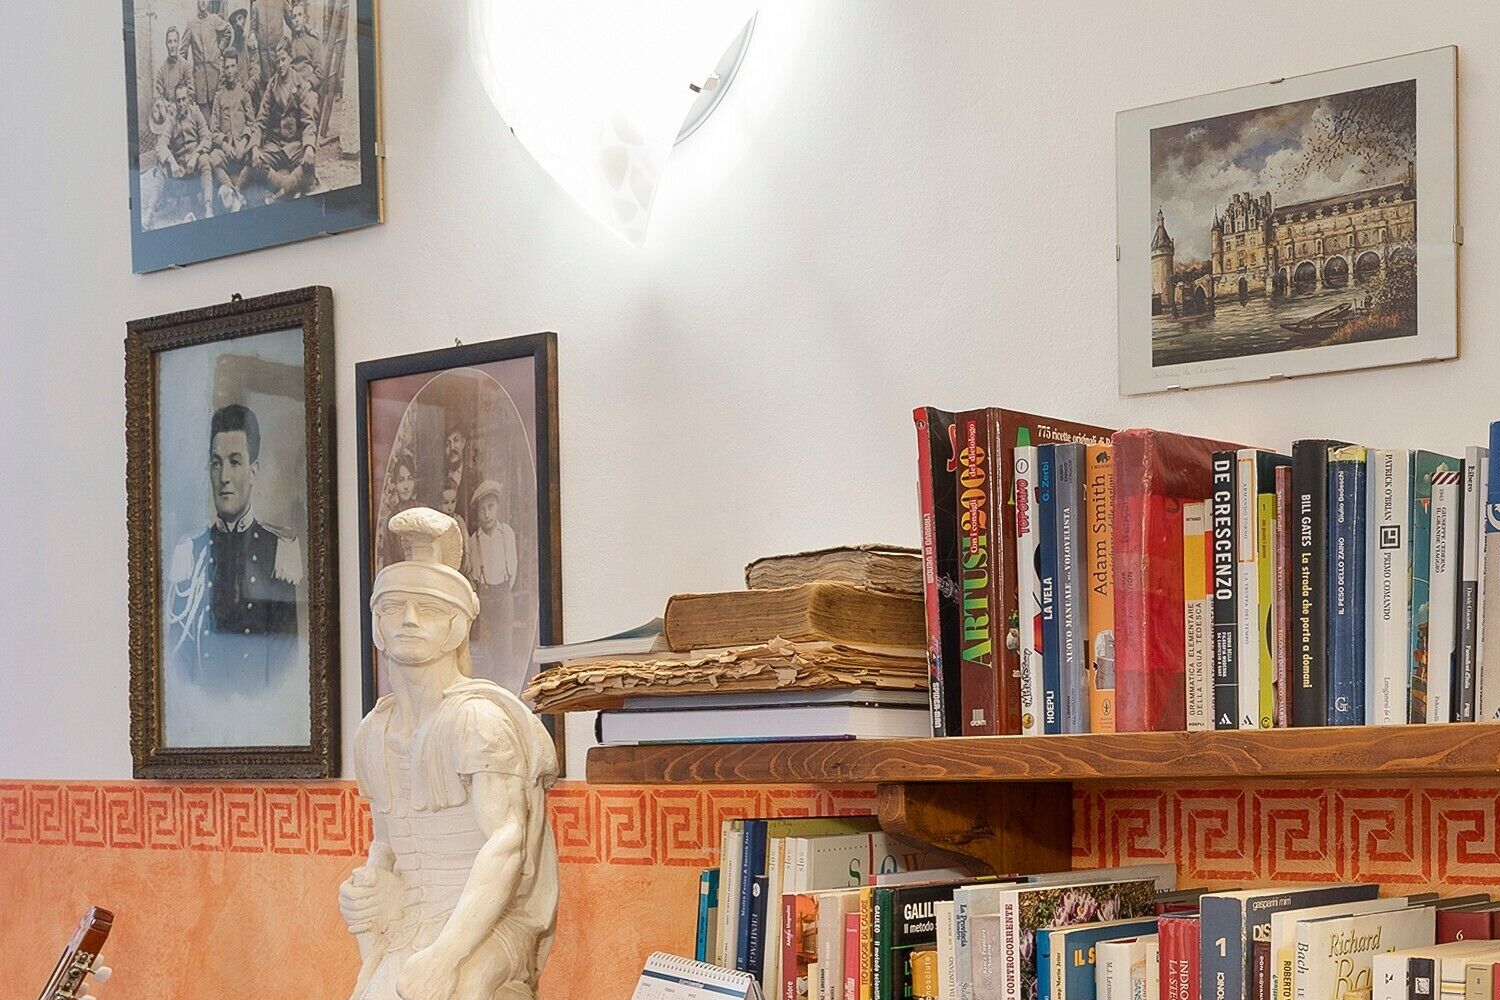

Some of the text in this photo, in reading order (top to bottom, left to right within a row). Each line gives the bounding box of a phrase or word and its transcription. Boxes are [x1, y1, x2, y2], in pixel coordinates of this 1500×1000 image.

[1041, 461, 1050, 502] G. Zerbi
[1301, 494, 1311, 514] BILL
[1062, 507, 1071, 571] VOLOVELISTA
[1092, 475, 1107, 597] Adam Smith
[1214, 460, 1232, 600] DE CRESCENZO
[1301, 516, 1312, 547] GATES
[960, 446, 993, 669] ARTUSI 2000
[1302, 552, 1312, 563] La
[1042, 577, 1053, 620] LA VELA
[1302, 566, 1312, 596] strada
[1302, 600, 1312, 614] che
[1300, 617, 1312, 643] porta
[1302, 654, 1313, 688] domani
[932, 683, 942, 728] SPIDER-MAN
[1046, 690, 1055, 723] HOEPLI
[749, 913, 759, 967] ERMITAGE
[1005, 904, 1014, 995] CONTROCORRENTE
[1214, 938, 1227, 964] 1
[1329, 925, 1381, 957] Richard
[1169, 960, 1178, 974] LA
[1180, 960, 1190, 1000] INDRO
[1282, 960, 1291, 997] ROBERTO
